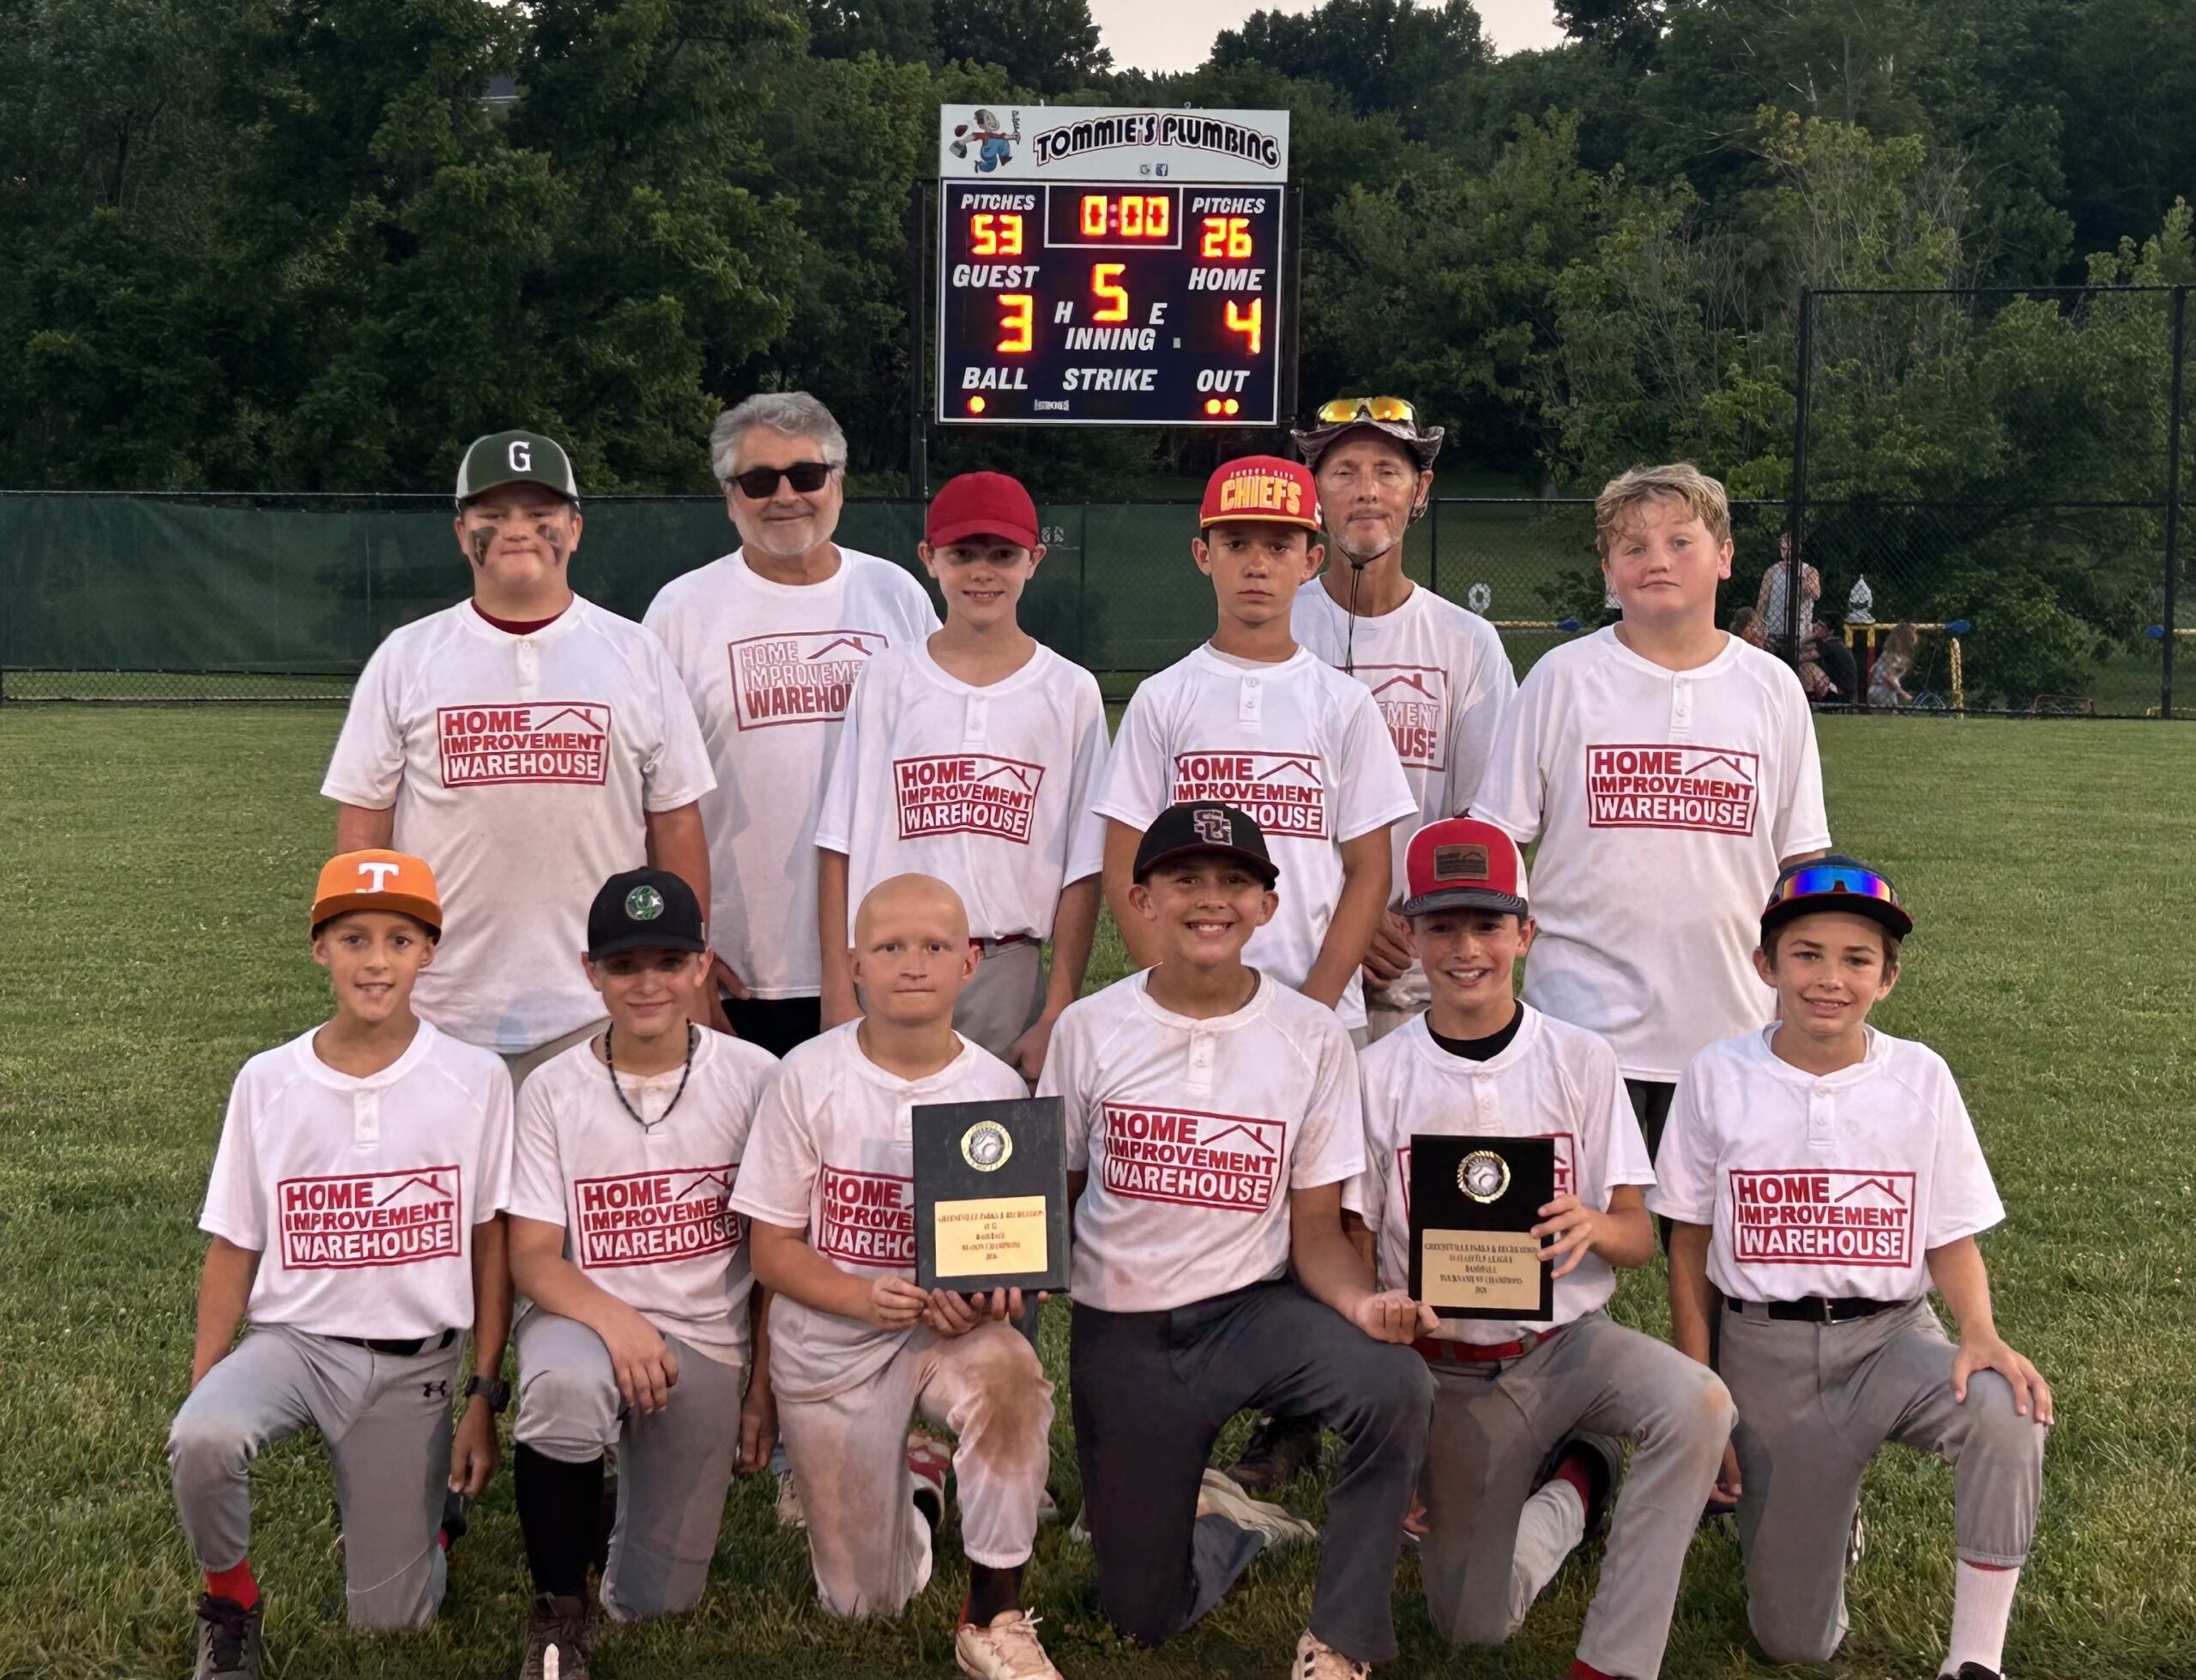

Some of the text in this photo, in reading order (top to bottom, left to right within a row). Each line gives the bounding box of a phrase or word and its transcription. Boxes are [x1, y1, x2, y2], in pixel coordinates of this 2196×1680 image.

[1035, 117, 1279, 166] TOMMIE'S PLUMBING
[961, 195, 1035, 211] PITCHES
[1080, 196, 1169, 237] 0:00
[1192, 197, 1265, 214] PITCHES
[971, 214, 1023, 256] 53
[1202, 218, 1252, 257] 26
[953, 265, 1040, 288] GUEST
[1188, 268, 1265, 291] HOME
[1092, 263, 1128, 322] 5
[997, 294, 1033, 352] 3
[1054, 301, 1074, 323] H
[1149, 302, 1167, 325] E
[1226, 298, 1262, 354] 4
[1065, 328, 1156, 351] INNING
[962, 367, 1029, 389] BALL
[1063, 369, 1158, 391] STRIKE
[1197, 370, 1251, 393] OUT
[509, 440, 532, 472] G
[1221, 475, 1301, 515] CHIEFS
[739, 641, 799, 669] HOME
[744, 659, 864, 691] IMPROVEME
[746, 683, 852, 719] WAREHO
[445, 710, 531, 736] HOME
[443, 732, 606, 755] IMPROVEMENT
[450, 753, 599, 779] WAREHOUSE
[902, 760, 976, 788] HOME
[1177, 757, 1253, 782] HOME
[1594, 751, 1682, 775] HOME
[902, 783, 1033, 810] IMPROVEMENT
[1173, 782, 1324, 804] IMPROVEMENT
[1591, 776, 1754, 801] IMPROVEMENT
[907, 801, 1028, 834] WAREHOUSE
[1240, 803, 1321, 829] HOUSE
[1597, 797, 1748, 826] WAREHOUSE
[355, 862, 399, 893] T
[1108, 1111, 1198, 1145] HOME
[1107, 1137, 1277, 1175] IMPROVEMENT
[583, 1177, 673, 1211] HOME
[824, 1171, 902, 1208] HOME
[1111, 1160, 1270, 1203] WAREHOUSE
[1738, 1177, 1830, 1204] HOME
[287, 1182, 373, 1212] HOME
[285, 1201, 455, 1231] IMPROVEMENT
[583, 1195, 729, 1231] IMPROVEMEN
[1738, 1204, 1908, 1227] IMPROVEMENT
[293, 1223, 452, 1260] WAREHOUSE
[591, 1215, 738, 1259] WAREHOUSE
[1742, 1228, 1902, 1256] WAREHOUSE
